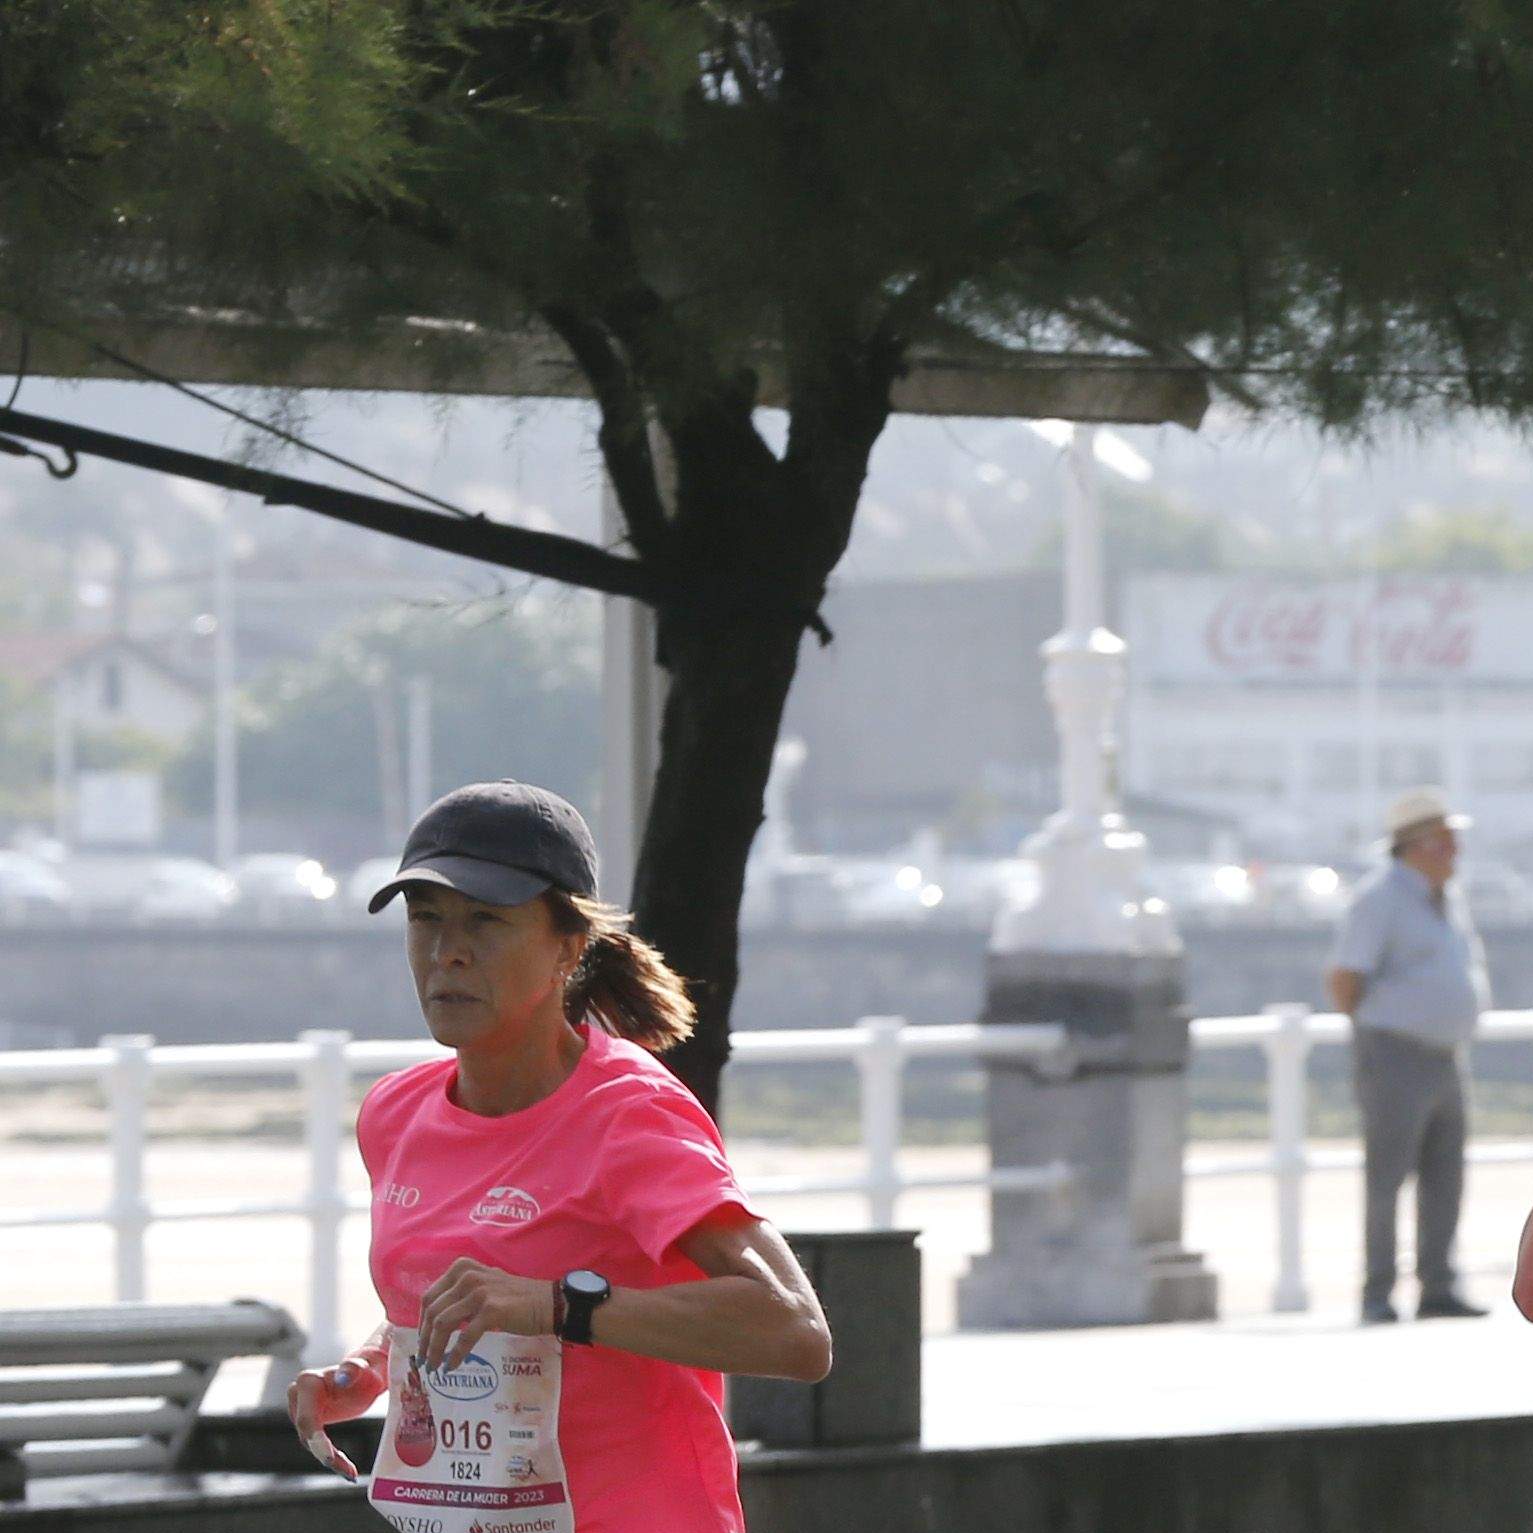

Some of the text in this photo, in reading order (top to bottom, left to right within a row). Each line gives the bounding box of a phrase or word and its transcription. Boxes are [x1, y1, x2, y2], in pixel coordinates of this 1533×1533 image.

[433, 1368, 494, 1389] ASTURIANA
[503, 1364, 541, 1376] SUMA
[440, 1419, 492, 1450] 016
[450, 1461, 481, 1480] 1824
[394, 1487, 544, 1504] CARRERA DE LA MUJER 2023
